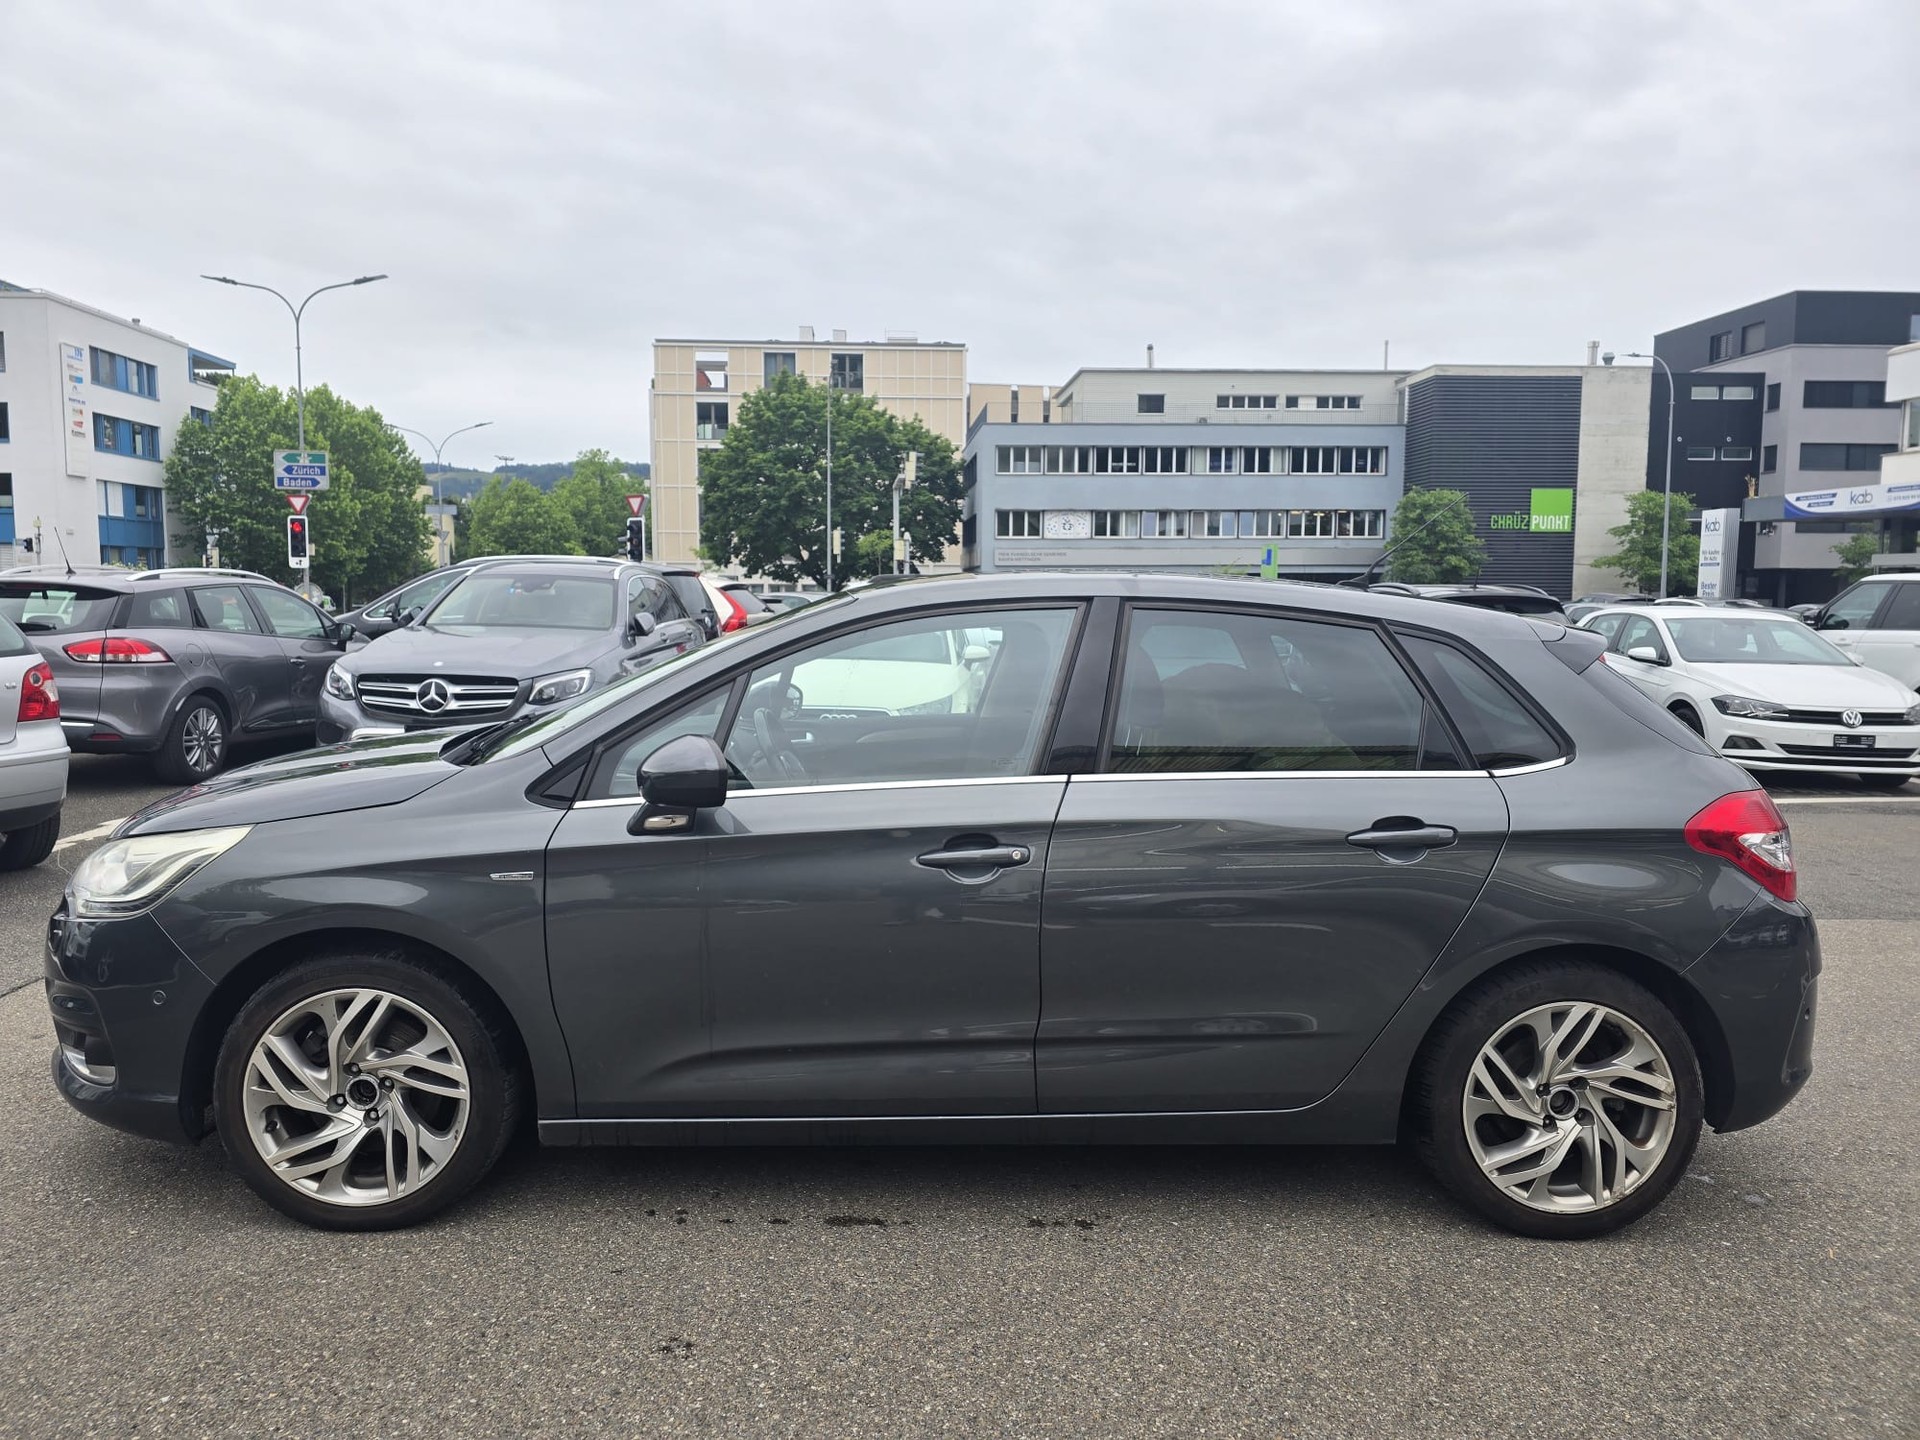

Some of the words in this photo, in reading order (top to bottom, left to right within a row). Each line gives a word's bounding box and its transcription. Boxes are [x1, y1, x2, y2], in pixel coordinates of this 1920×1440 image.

[292, 466, 321, 475] Zürich
[283, 477, 313, 487] Baden
[1850, 488, 1873, 505] kab
[1704, 518, 1721, 533] kab
